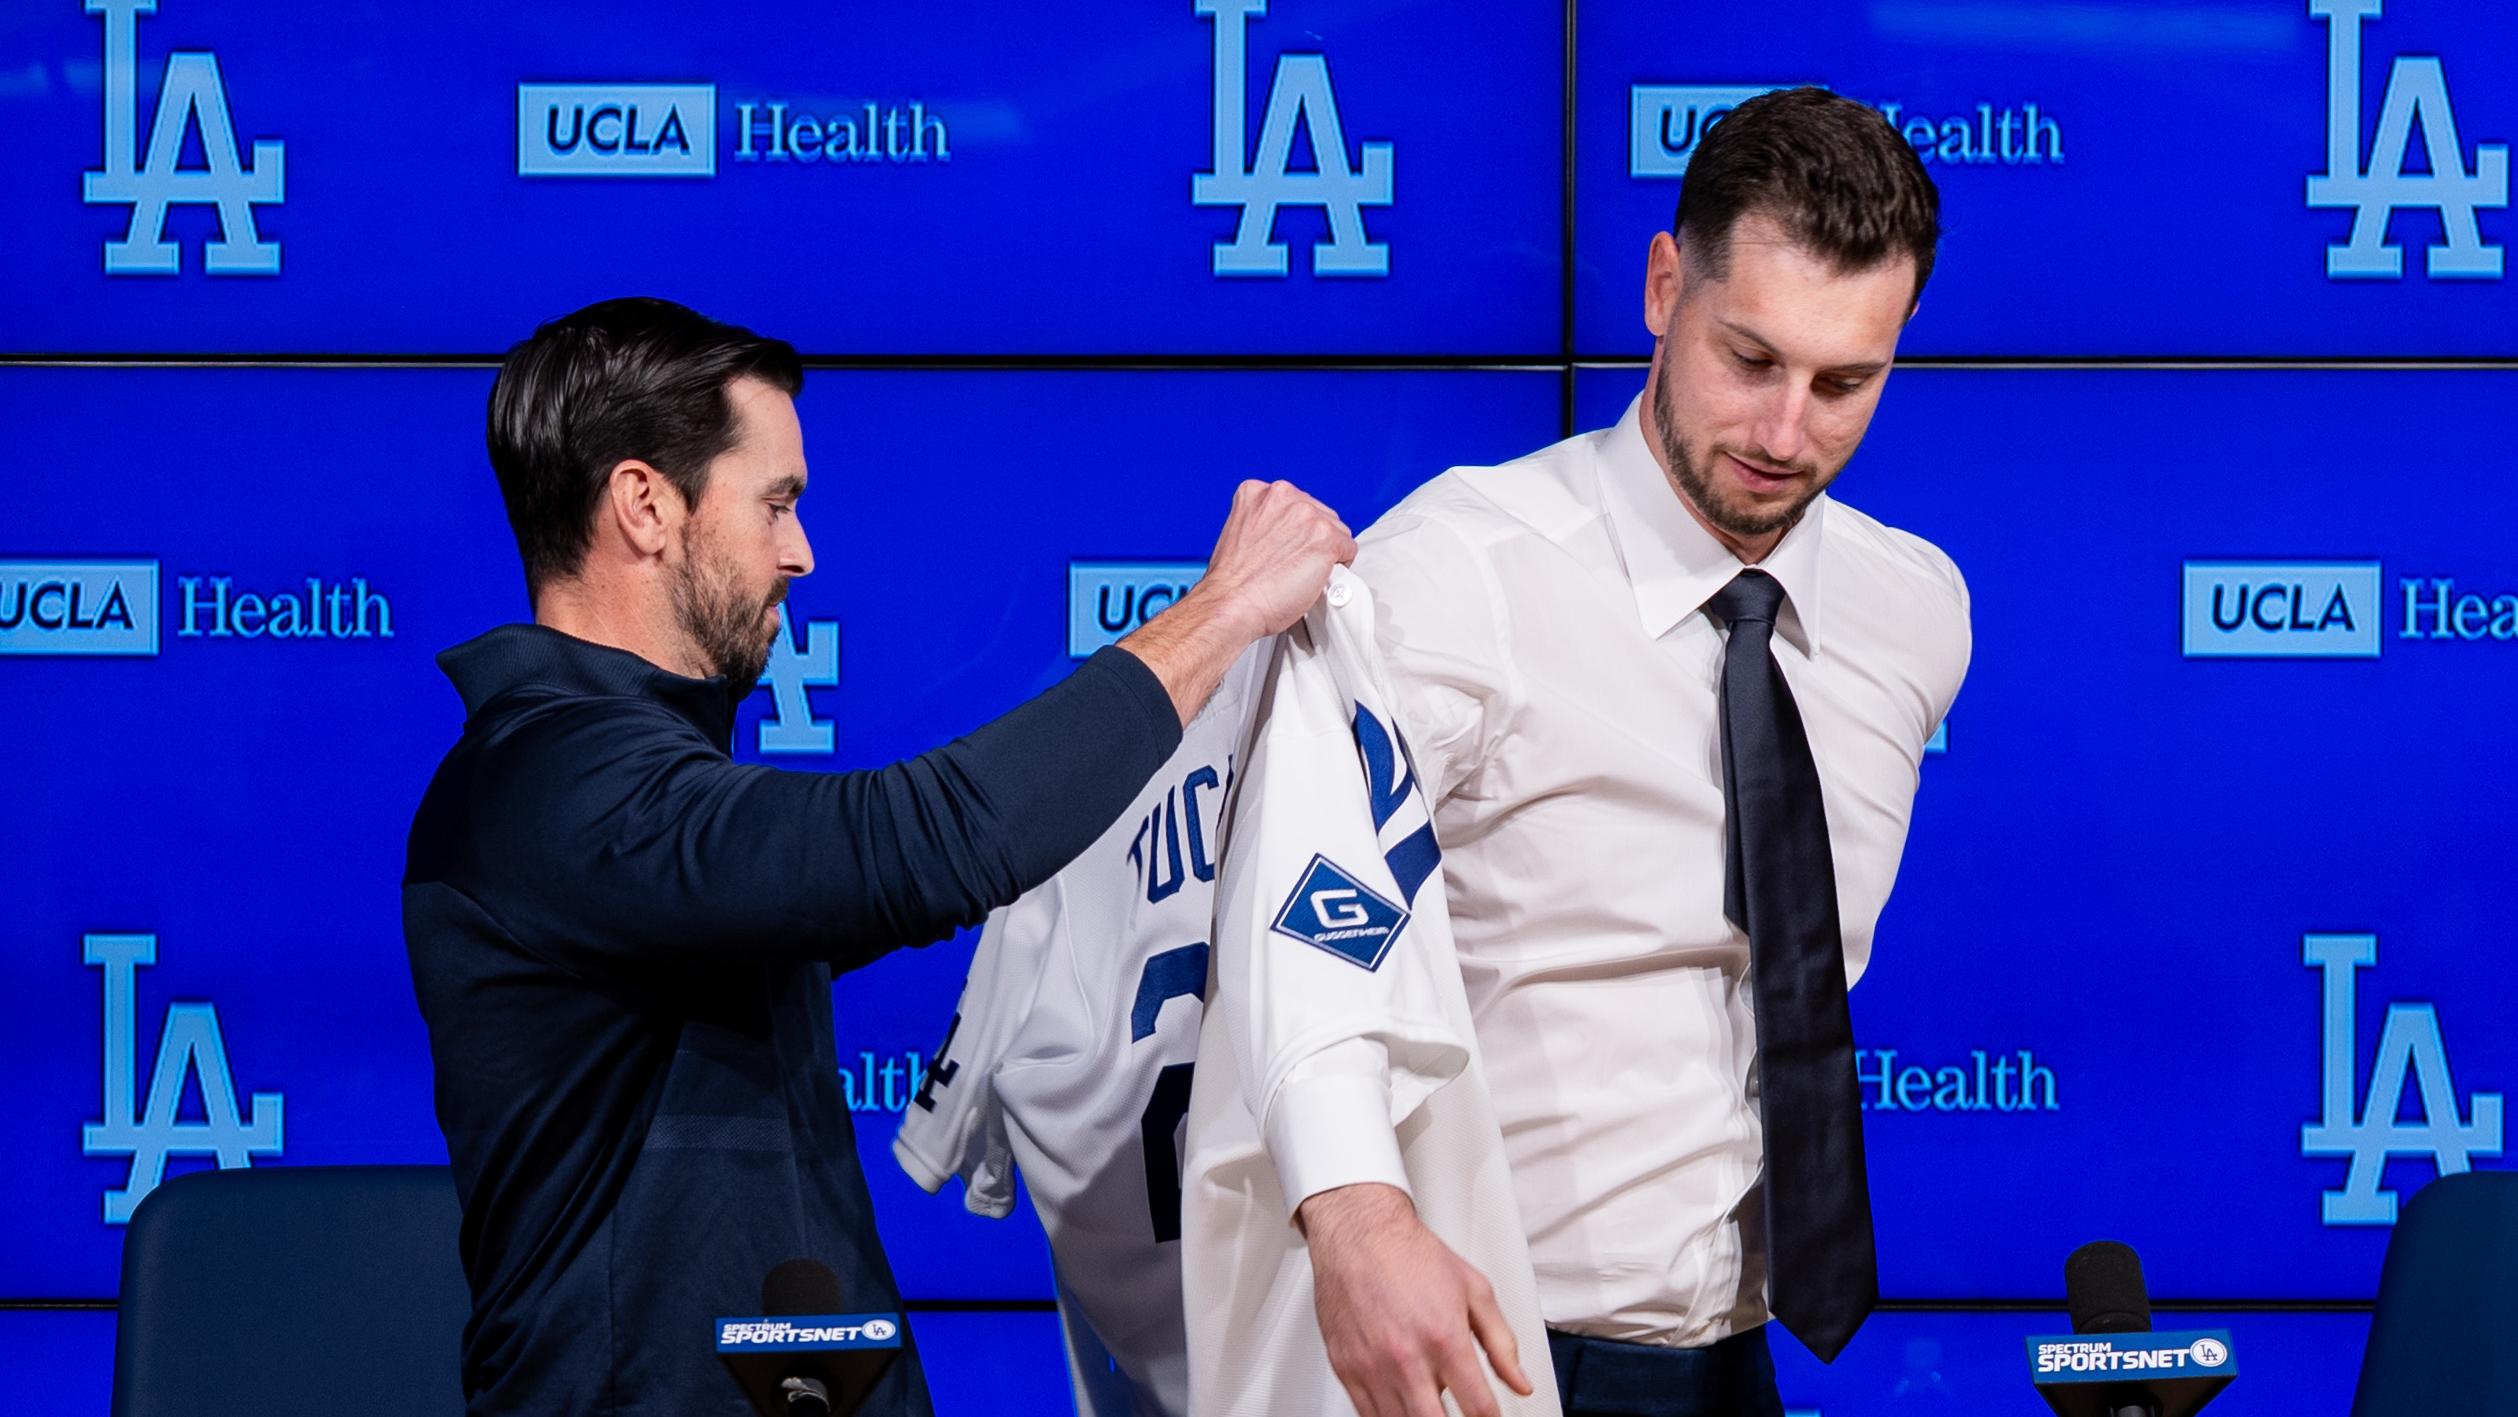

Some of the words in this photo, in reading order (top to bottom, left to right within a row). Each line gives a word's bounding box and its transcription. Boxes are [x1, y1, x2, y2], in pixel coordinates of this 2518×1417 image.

[84, 0, 285, 274] LA
[547, 104, 691, 155] UCLA
[735, 102, 951, 162] Health
[1192, 0, 1394, 277] LA
[1880, 102, 2065, 165] ealth
[2306, 0, 2509, 278] LA
[177, 576, 394, 638] Health
[2211, 583, 2356, 633] UCLA
[1310, 888, 1369, 928] G
[83, 933, 284, 1225] LA
[2302, 933, 2504, 1225] LA
[720, 1327, 862, 1344] SPORTSNET
[723, 1320, 792, 1332] SPECTRUM
[2038, 1342, 2112, 1355] SPECTRUM
[2037, 1349, 2190, 1373] SPORTSNET
